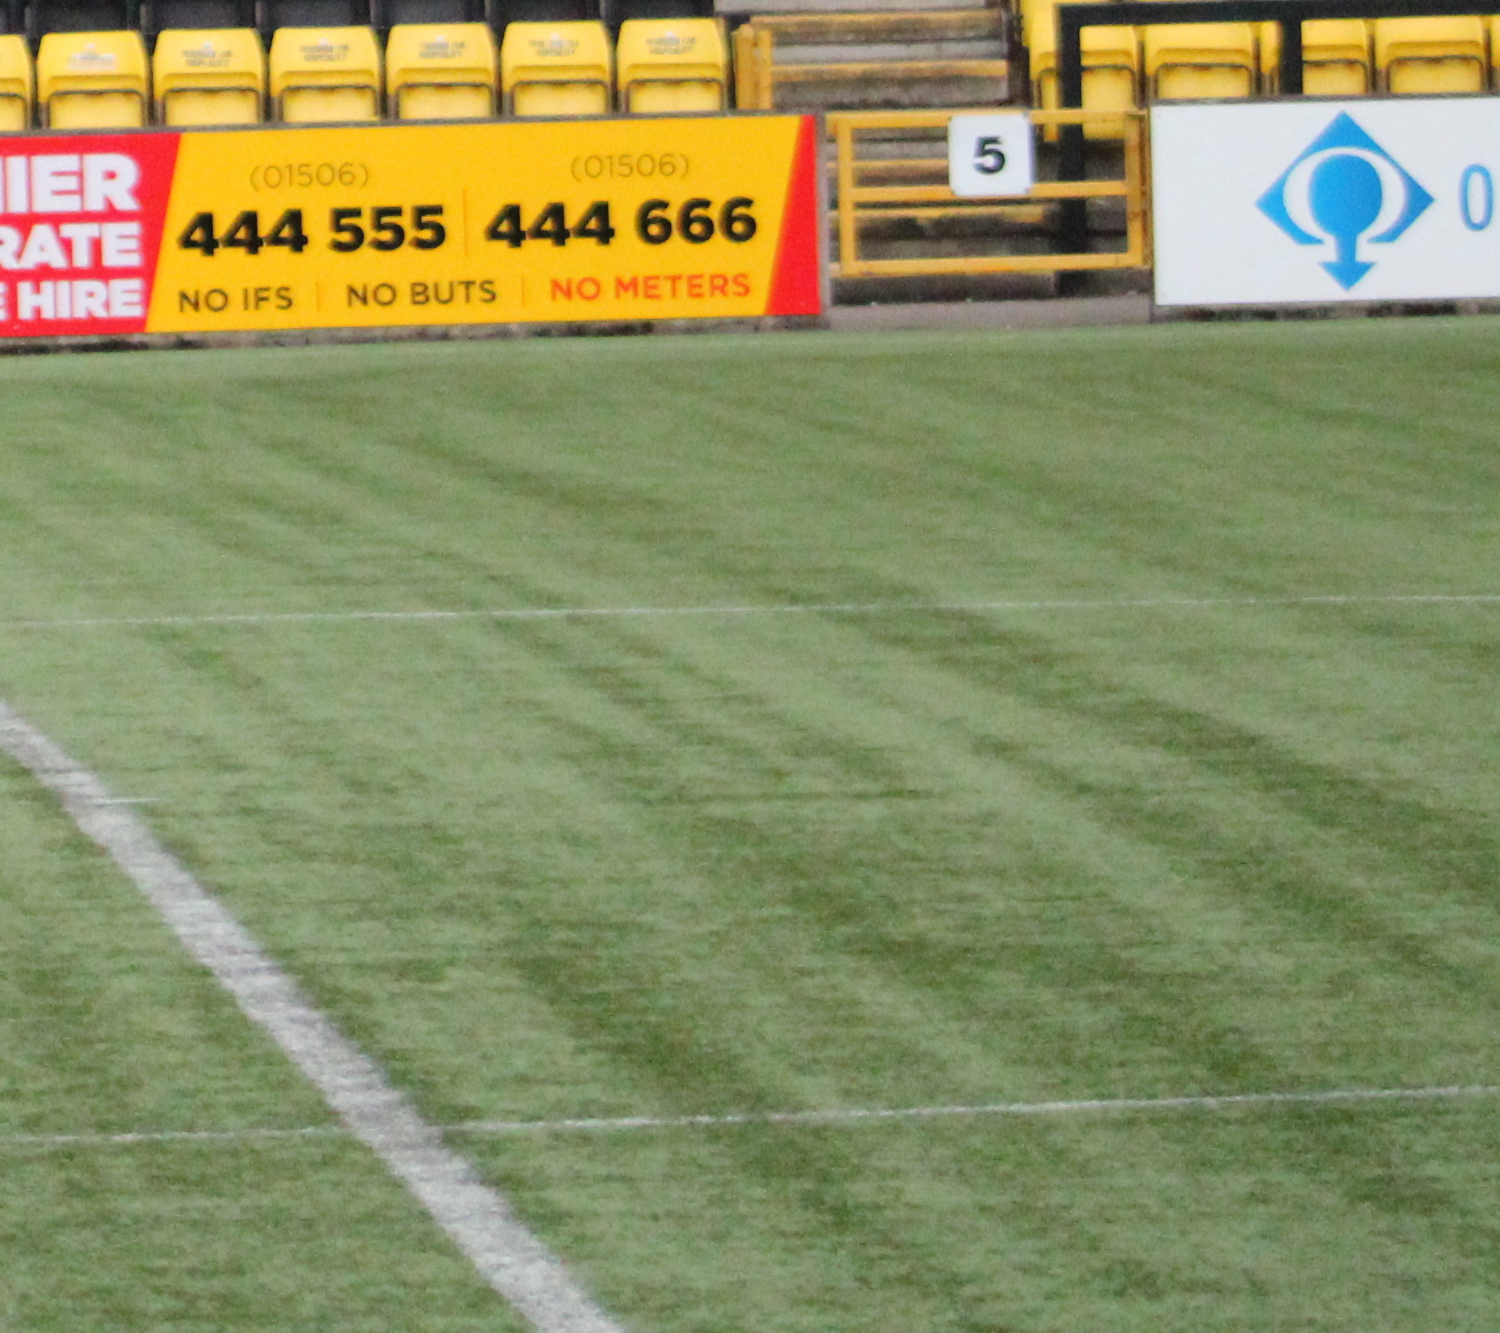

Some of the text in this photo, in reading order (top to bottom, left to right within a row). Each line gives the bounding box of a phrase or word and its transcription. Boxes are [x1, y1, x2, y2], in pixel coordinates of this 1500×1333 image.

[569, 152, 691, 182] (01506)
[973, 137, 1006, 174] 5
[249, 161, 370, 190] (01506)
[177, 205, 449, 257] 444 555
[485, 197, 758, 248] 444 666
[18, 278, 146, 320] HIRE
[177, 286, 294, 315] NO IFS
[346, 278, 498, 309] NO BUTS
[550, 271, 751, 303] NO METERS
